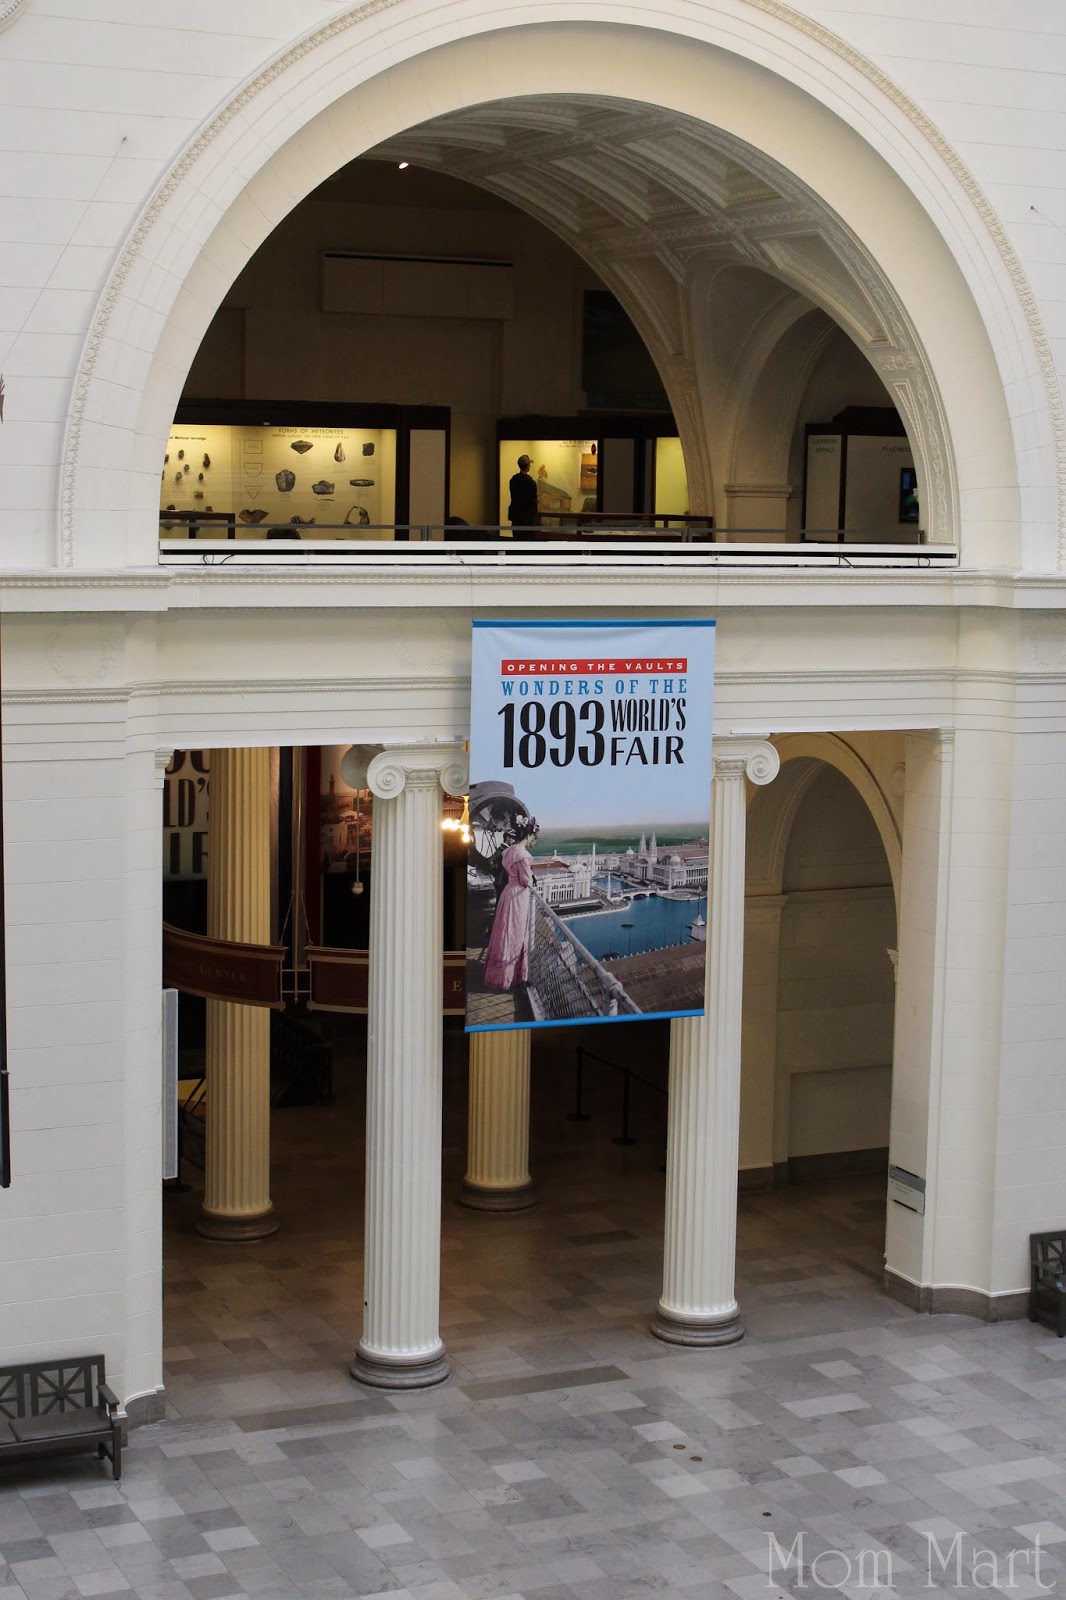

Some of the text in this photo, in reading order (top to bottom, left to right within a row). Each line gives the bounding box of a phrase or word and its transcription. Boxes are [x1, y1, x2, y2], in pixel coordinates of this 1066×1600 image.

[507, 662, 684, 671] OPENING THE VAULTS
[501, 678, 687, 696] WONDERS OF THE
[497, 698, 686, 768] 1893 WORLD'S
[610, 735, 684, 766] FAIR
